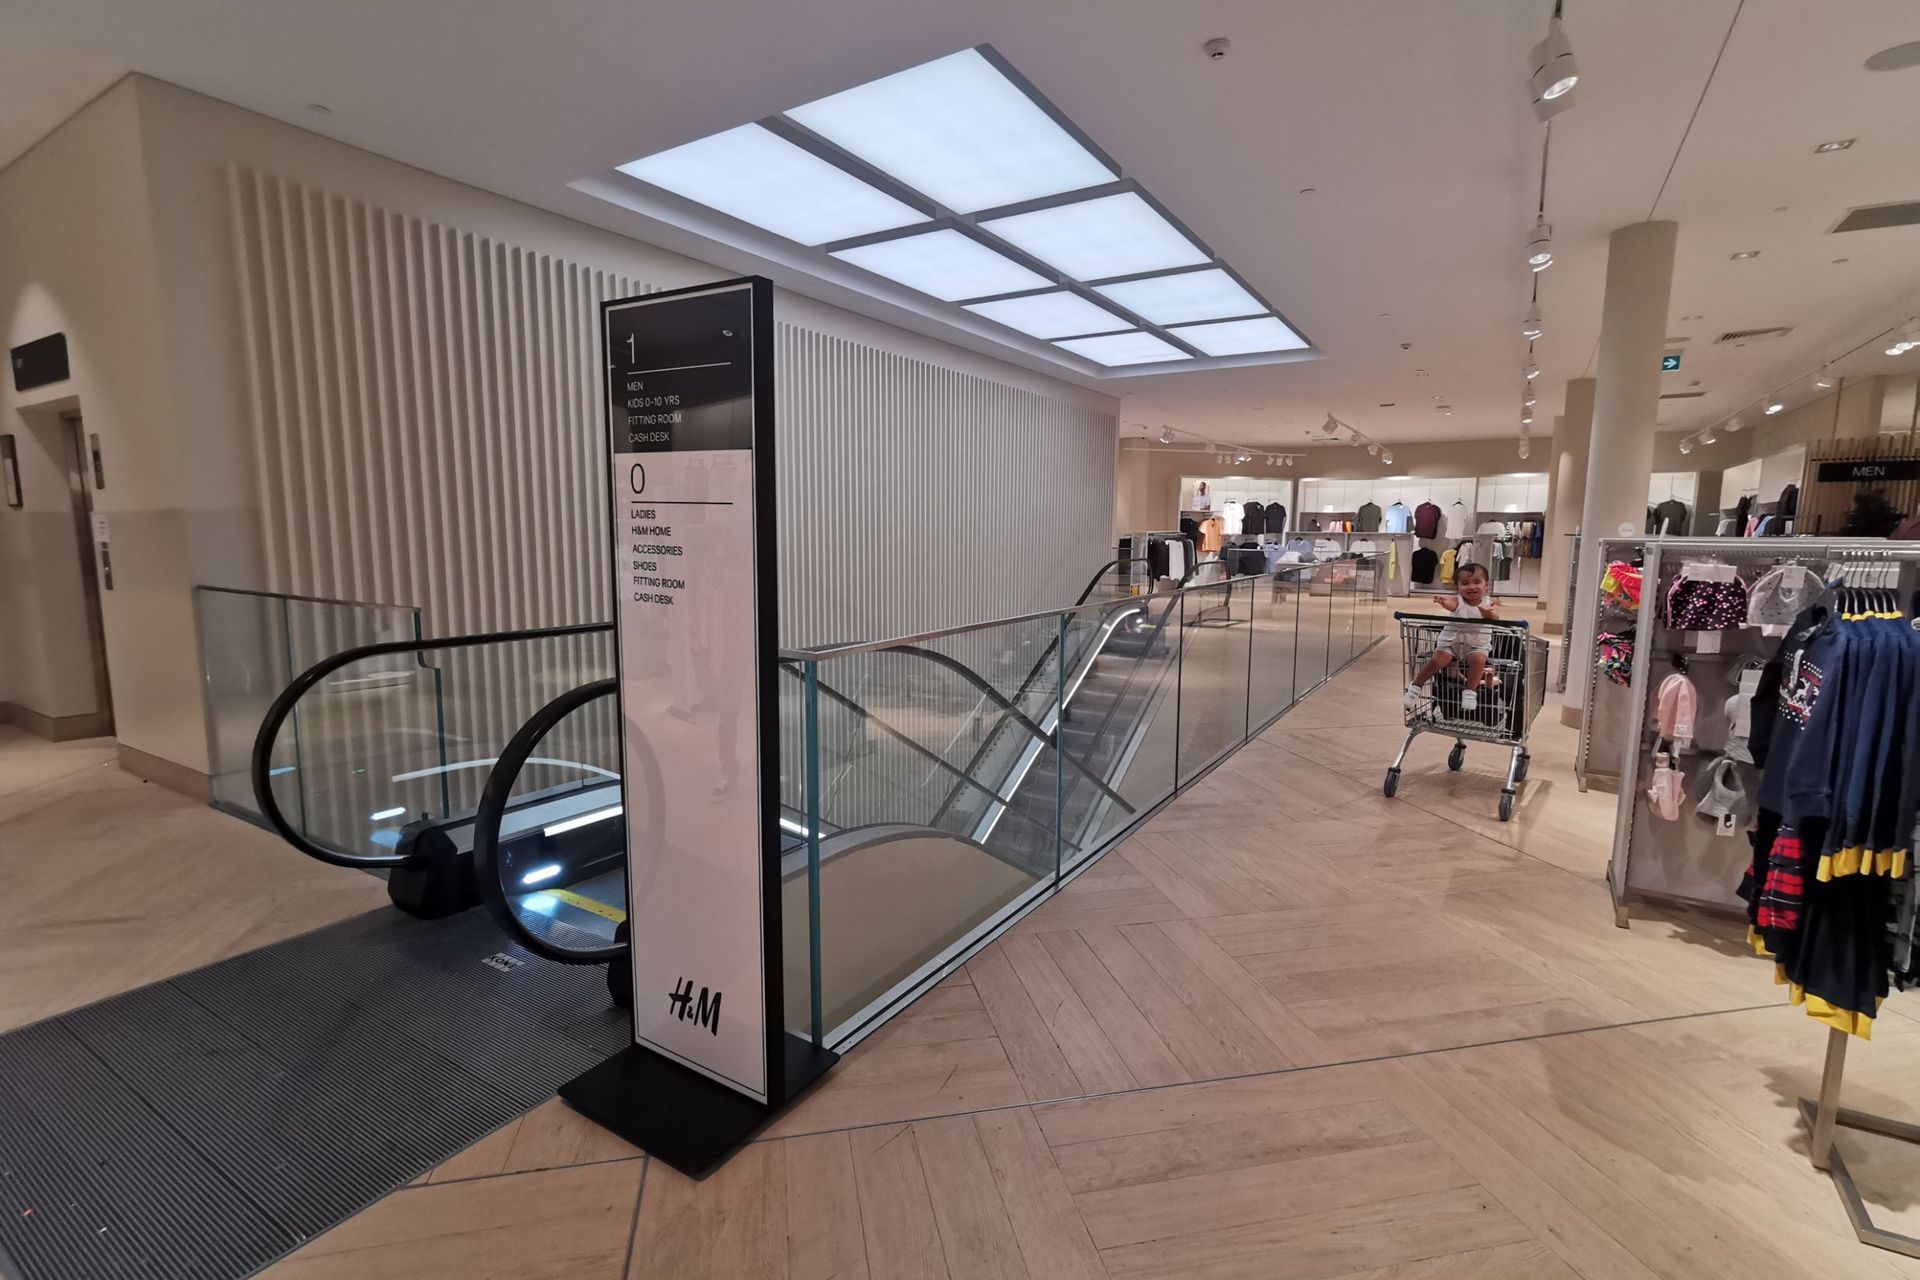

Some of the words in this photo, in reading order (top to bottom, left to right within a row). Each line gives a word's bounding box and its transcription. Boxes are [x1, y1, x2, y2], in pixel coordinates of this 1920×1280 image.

[627, 333, 635, 364] 1
[627, 381, 643, 391] MEN
[627, 397, 644, 408] KIDS
[645, 396, 662, 407] 0-10
[664, 395, 680, 406] YRS
[628, 415, 656, 426] FITTING
[658, 413, 682, 424] ROOM
[629, 432, 649, 443] CASH
[650, 431, 670, 442] DESK
[1852, 466, 1886, 476] MEN
[630, 463, 645, 494] 0
[631, 509, 656, 520] LADIES
[631, 526, 648, 536] H&M
[649, 526, 671, 537] HOME
[632, 544, 683, 556] ACCESSORIES
[633, 561, 657, 572] SHOES
[633, 576, 661, 588] FITTING
[661, 578, 685, 590] ROOM
[634, 592, 653, 603] CASH
[654, 594, 674, 605] DESK
[668, 976, 722, 1037] H&M
